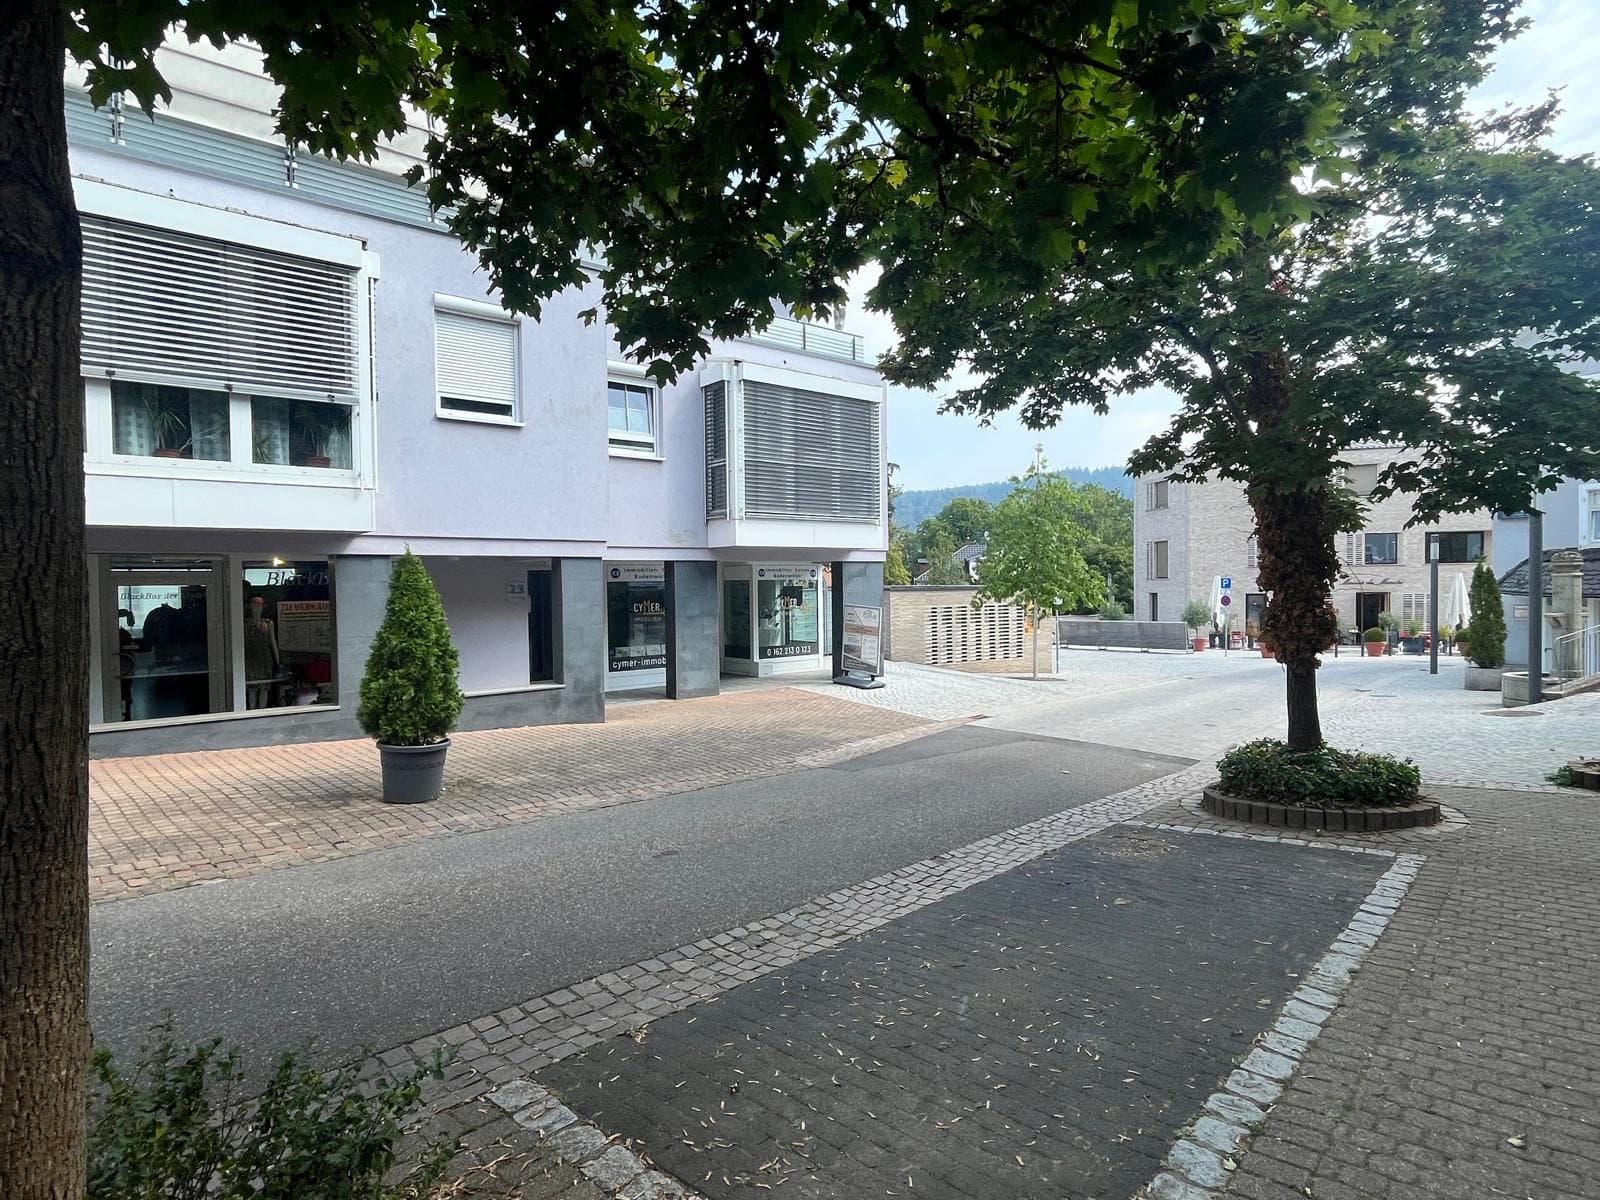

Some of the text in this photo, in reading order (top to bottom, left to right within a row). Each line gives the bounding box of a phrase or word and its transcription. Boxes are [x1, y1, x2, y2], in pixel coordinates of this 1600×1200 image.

[509, 583, 525, 594] 23
[633, 600, 661, 613] CYMER
[766, 648, 772, 656] 0
[773, 647, 784, 656] 162
[785, 646, 795, 655] 213
[795, 646, 800, 654] 0
[612, 657, 667, 670] cymer-immob
